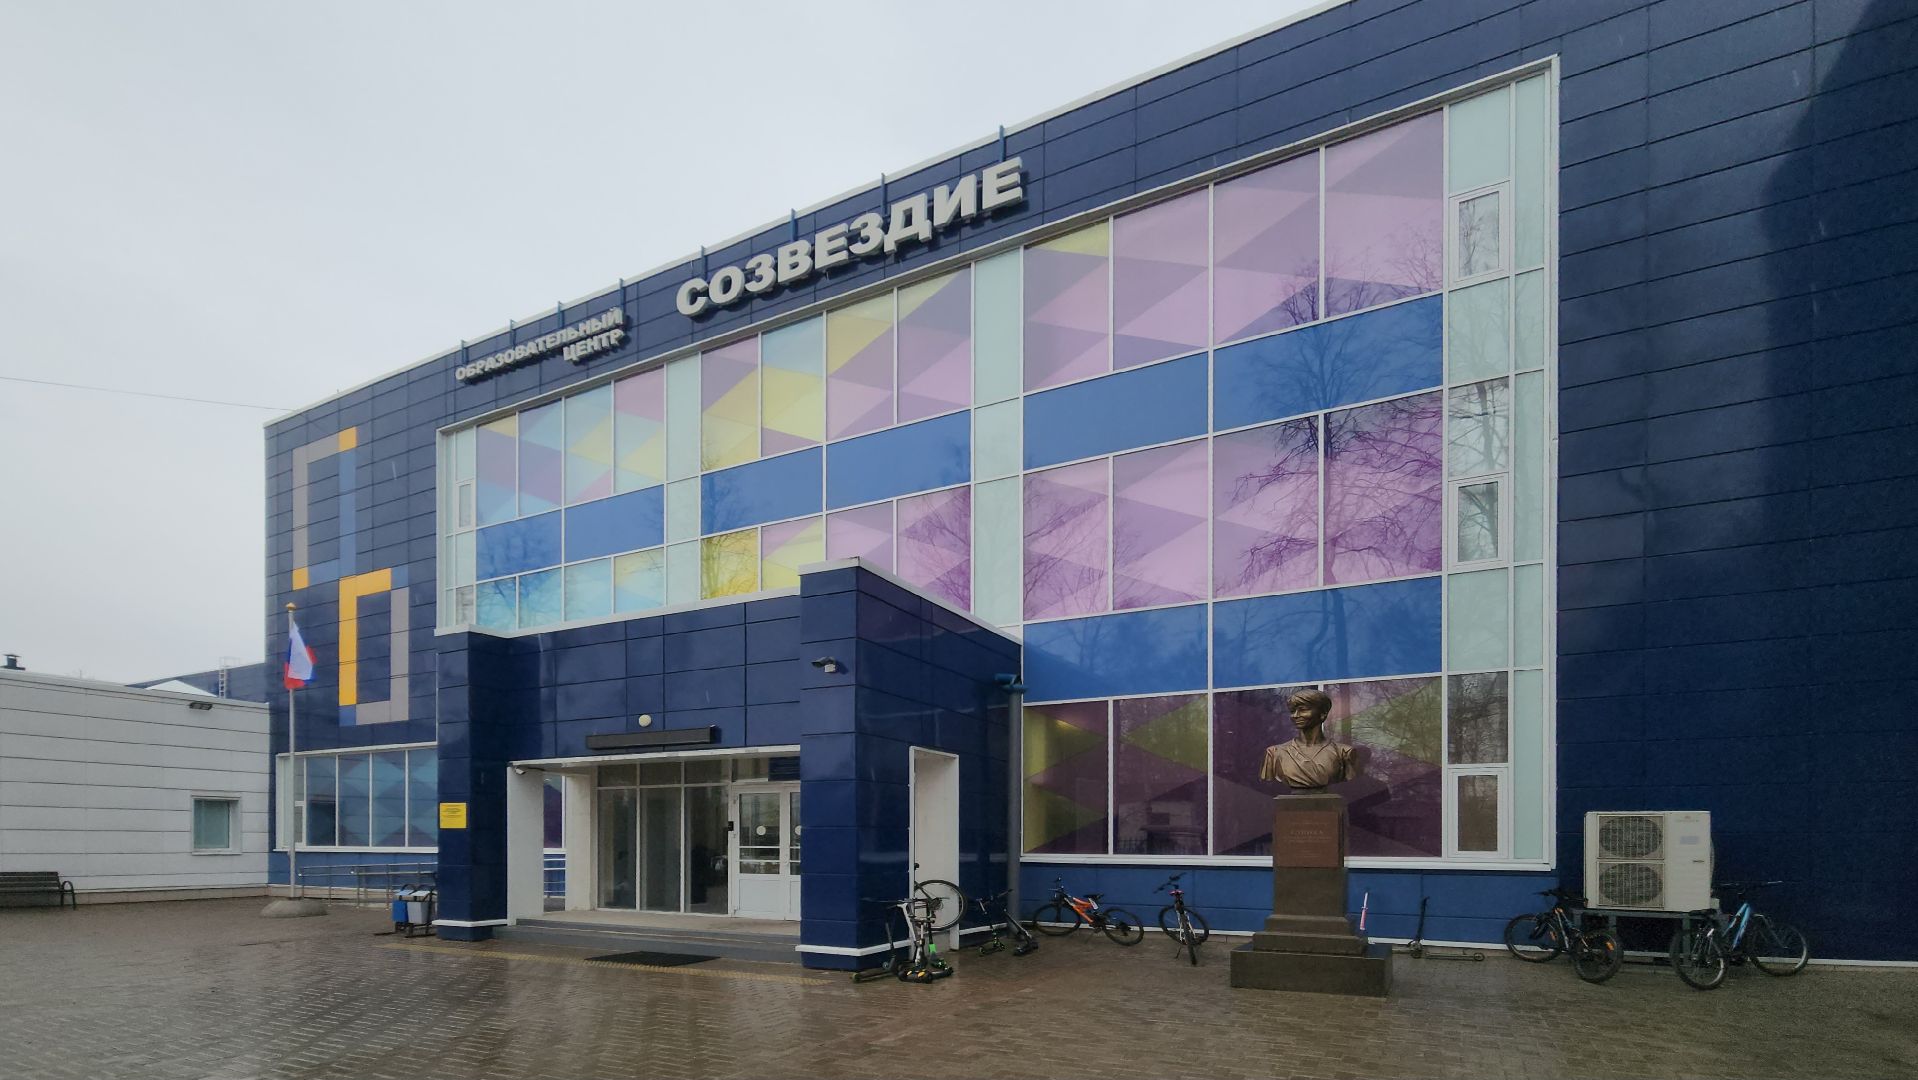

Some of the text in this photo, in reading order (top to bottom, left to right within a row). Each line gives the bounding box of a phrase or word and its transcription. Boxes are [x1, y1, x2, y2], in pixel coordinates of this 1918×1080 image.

[676, 156, 1024, 317] СОЗВЕЗДИЕ
[455, 306, 624, 381] ОБРАЗОВАТЕЛЬНЫЙ
[563, 328, 626, 362] ЦЕНТР
